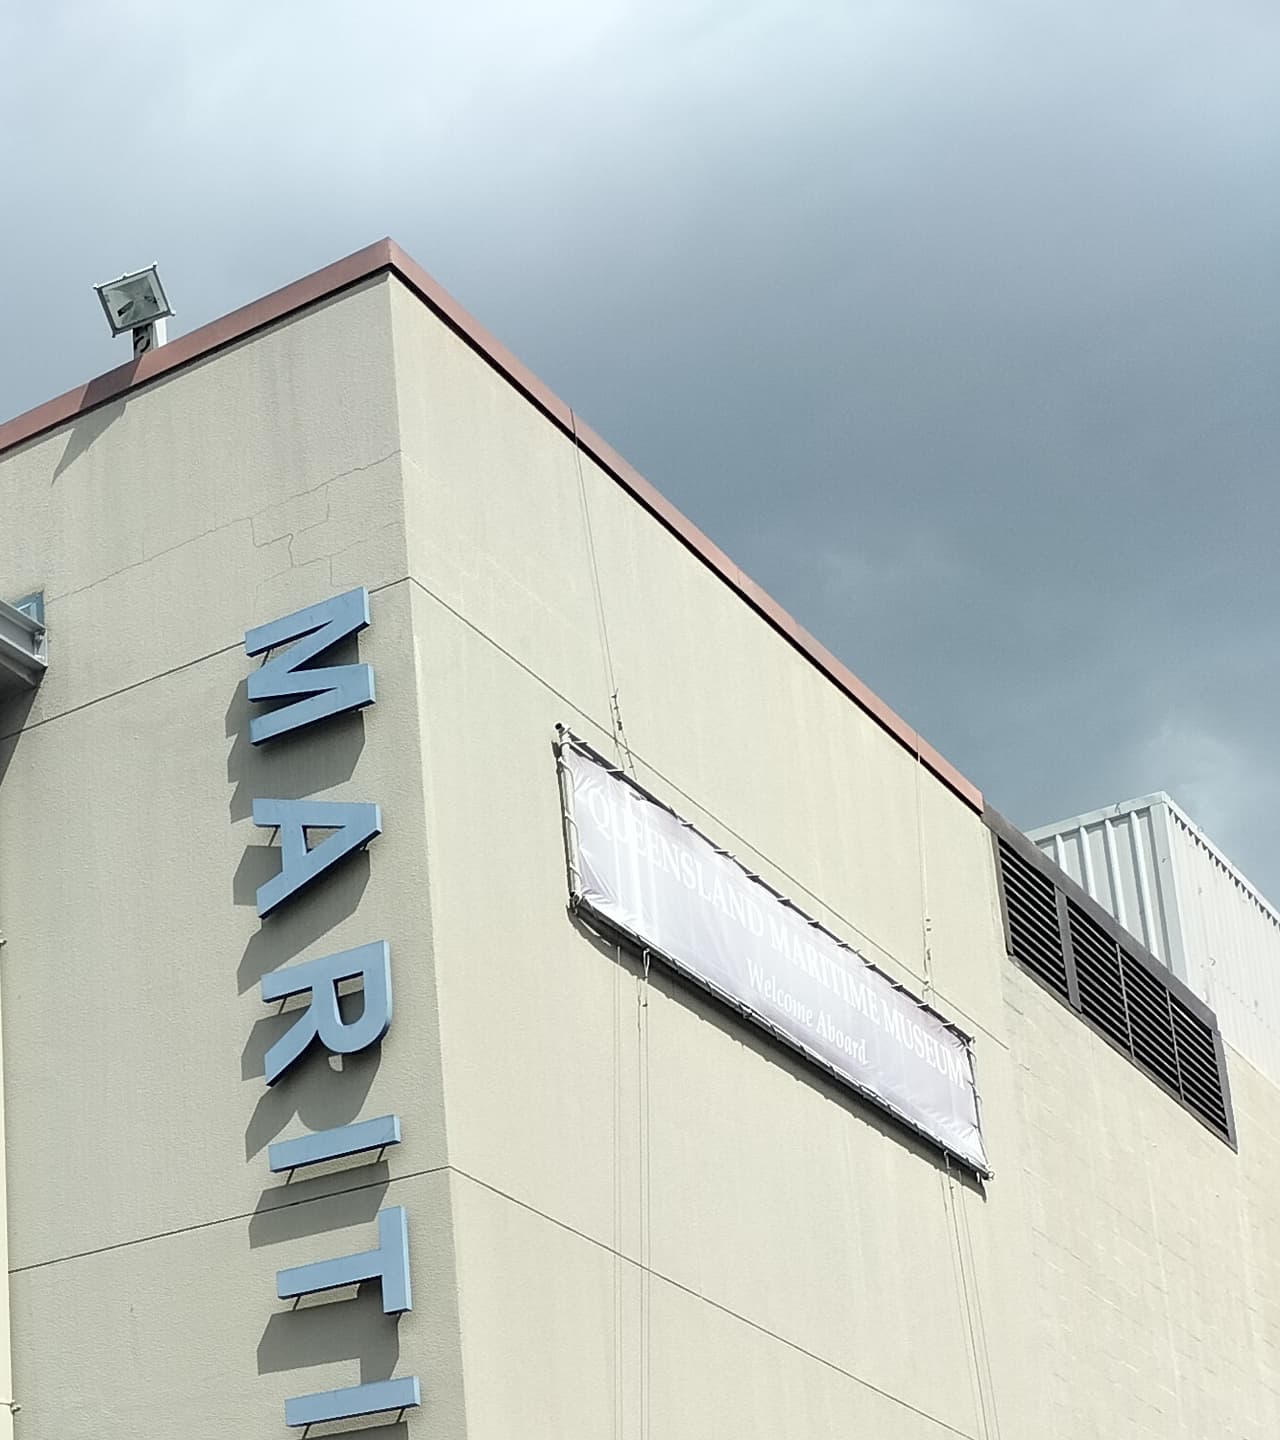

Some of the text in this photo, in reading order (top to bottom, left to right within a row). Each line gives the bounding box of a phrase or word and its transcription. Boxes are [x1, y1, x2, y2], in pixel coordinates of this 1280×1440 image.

[589, 787, 968, 1090] QUEENSLAND MARITIME MUSEUM
[746, 958, 813, 1026] Welcome
